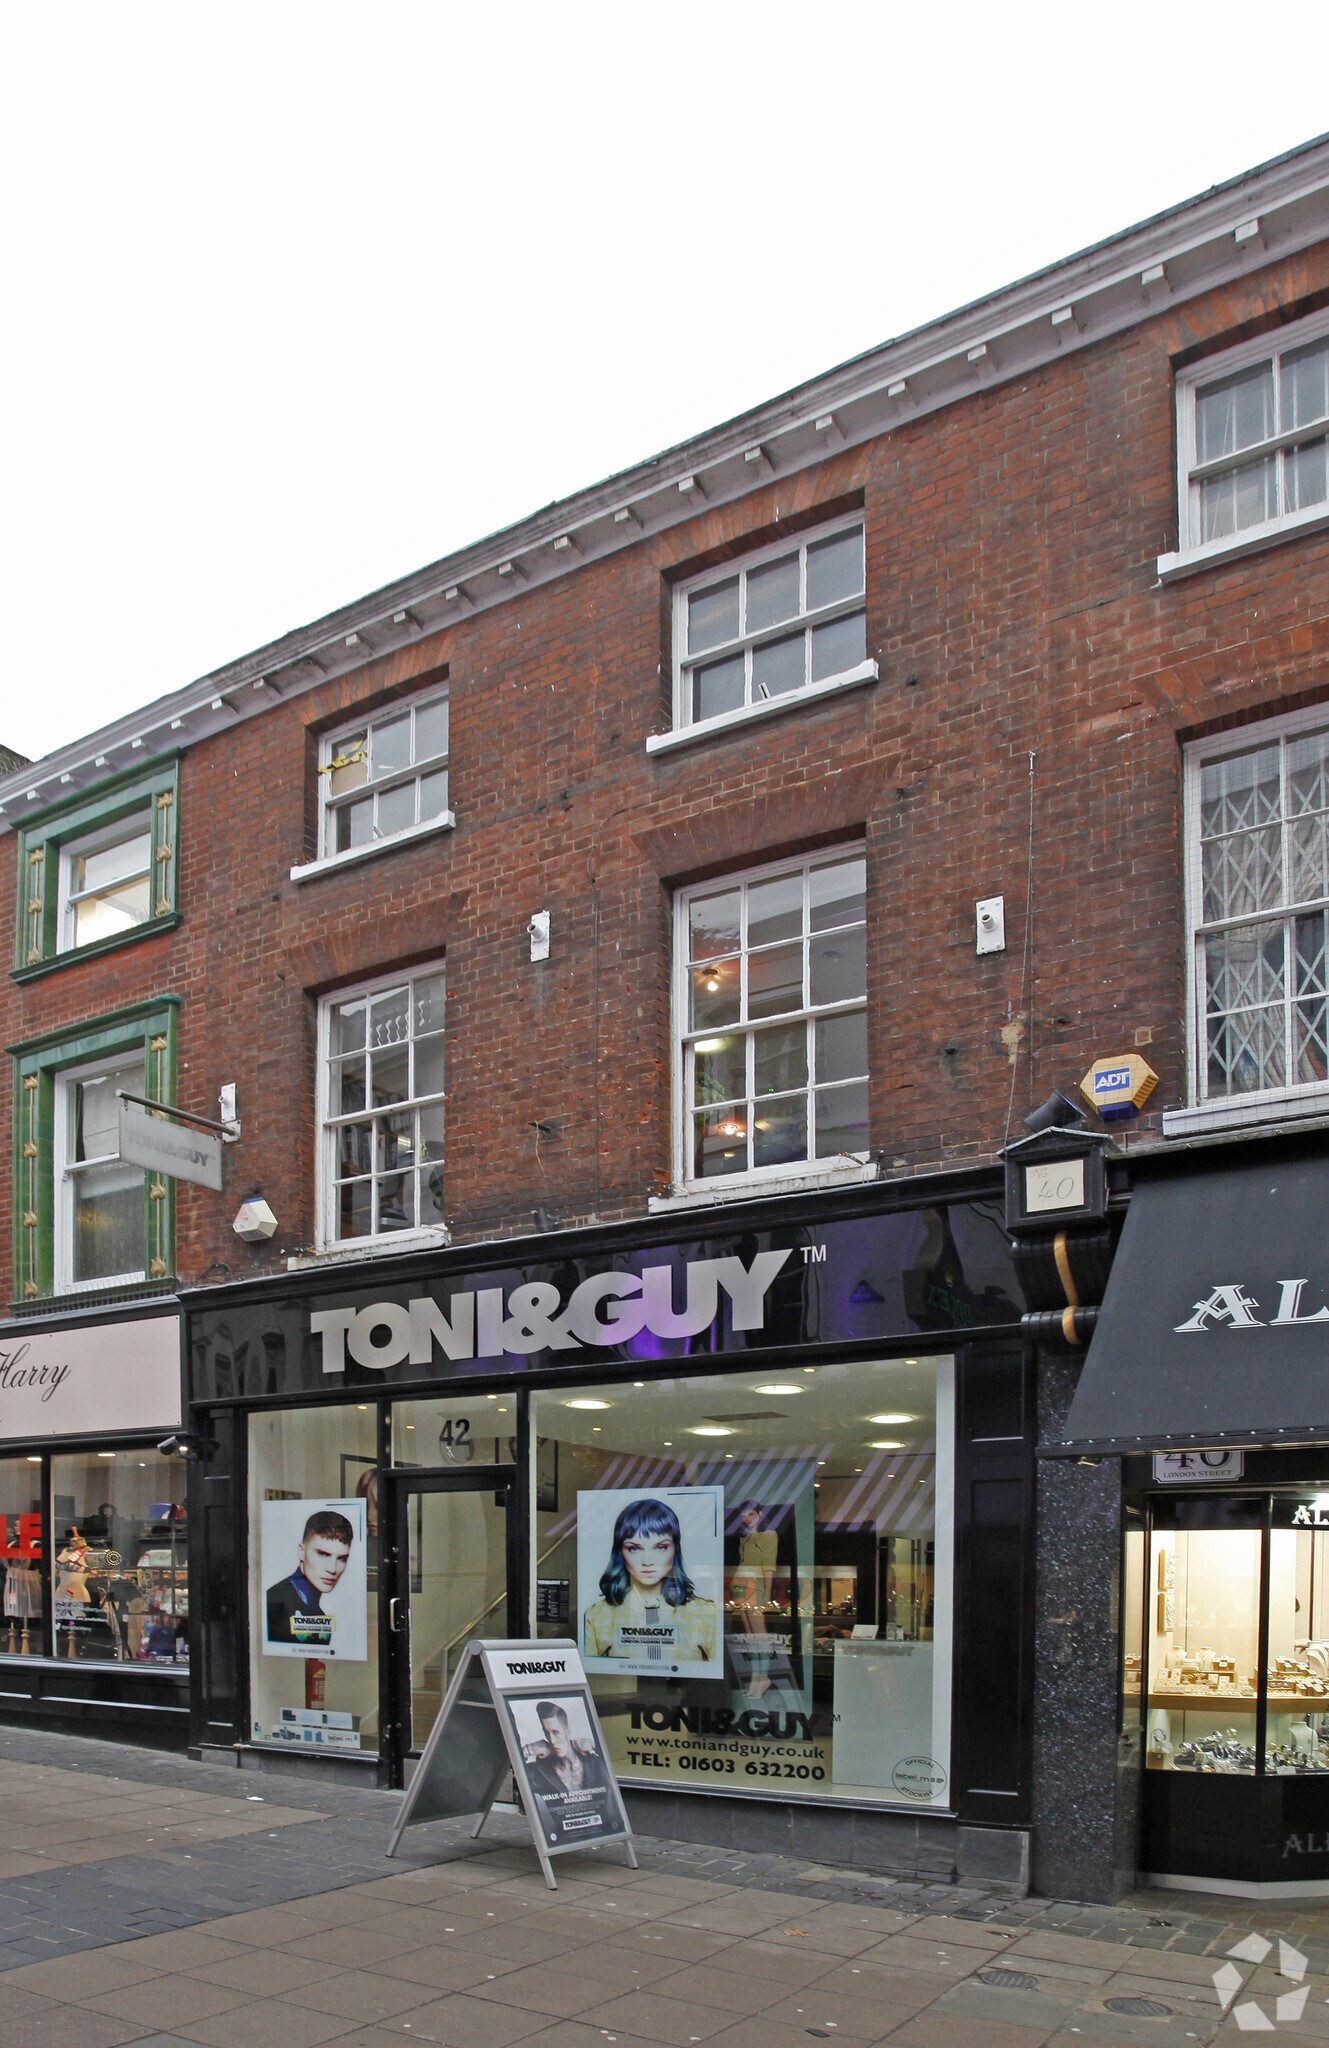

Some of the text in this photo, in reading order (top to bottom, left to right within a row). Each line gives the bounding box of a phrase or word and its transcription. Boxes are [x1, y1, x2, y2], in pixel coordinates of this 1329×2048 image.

[1094, 1071, 1130, 1089] ADT
[1037, 1176, 1075, 1202] 40
[310, 1244, 827, 1374] TONI&GUY TM
[439, 1418, 470, 1446] 42
[1199, 1469, 1233, 1477] STREET
[293, 1617, 333, 1626] TONI&GUY
[621, 1627, 675, 1637] TONI&GUY
[506, 1660, 567, 1675] TONI&GUY
[626, 1703, 823, 1741] TONI&GUY
[626, 1736, 825, 1759] www.toniandguy.co.uk
[627, 1751, 826, 1780] TEL: 01603 632200
